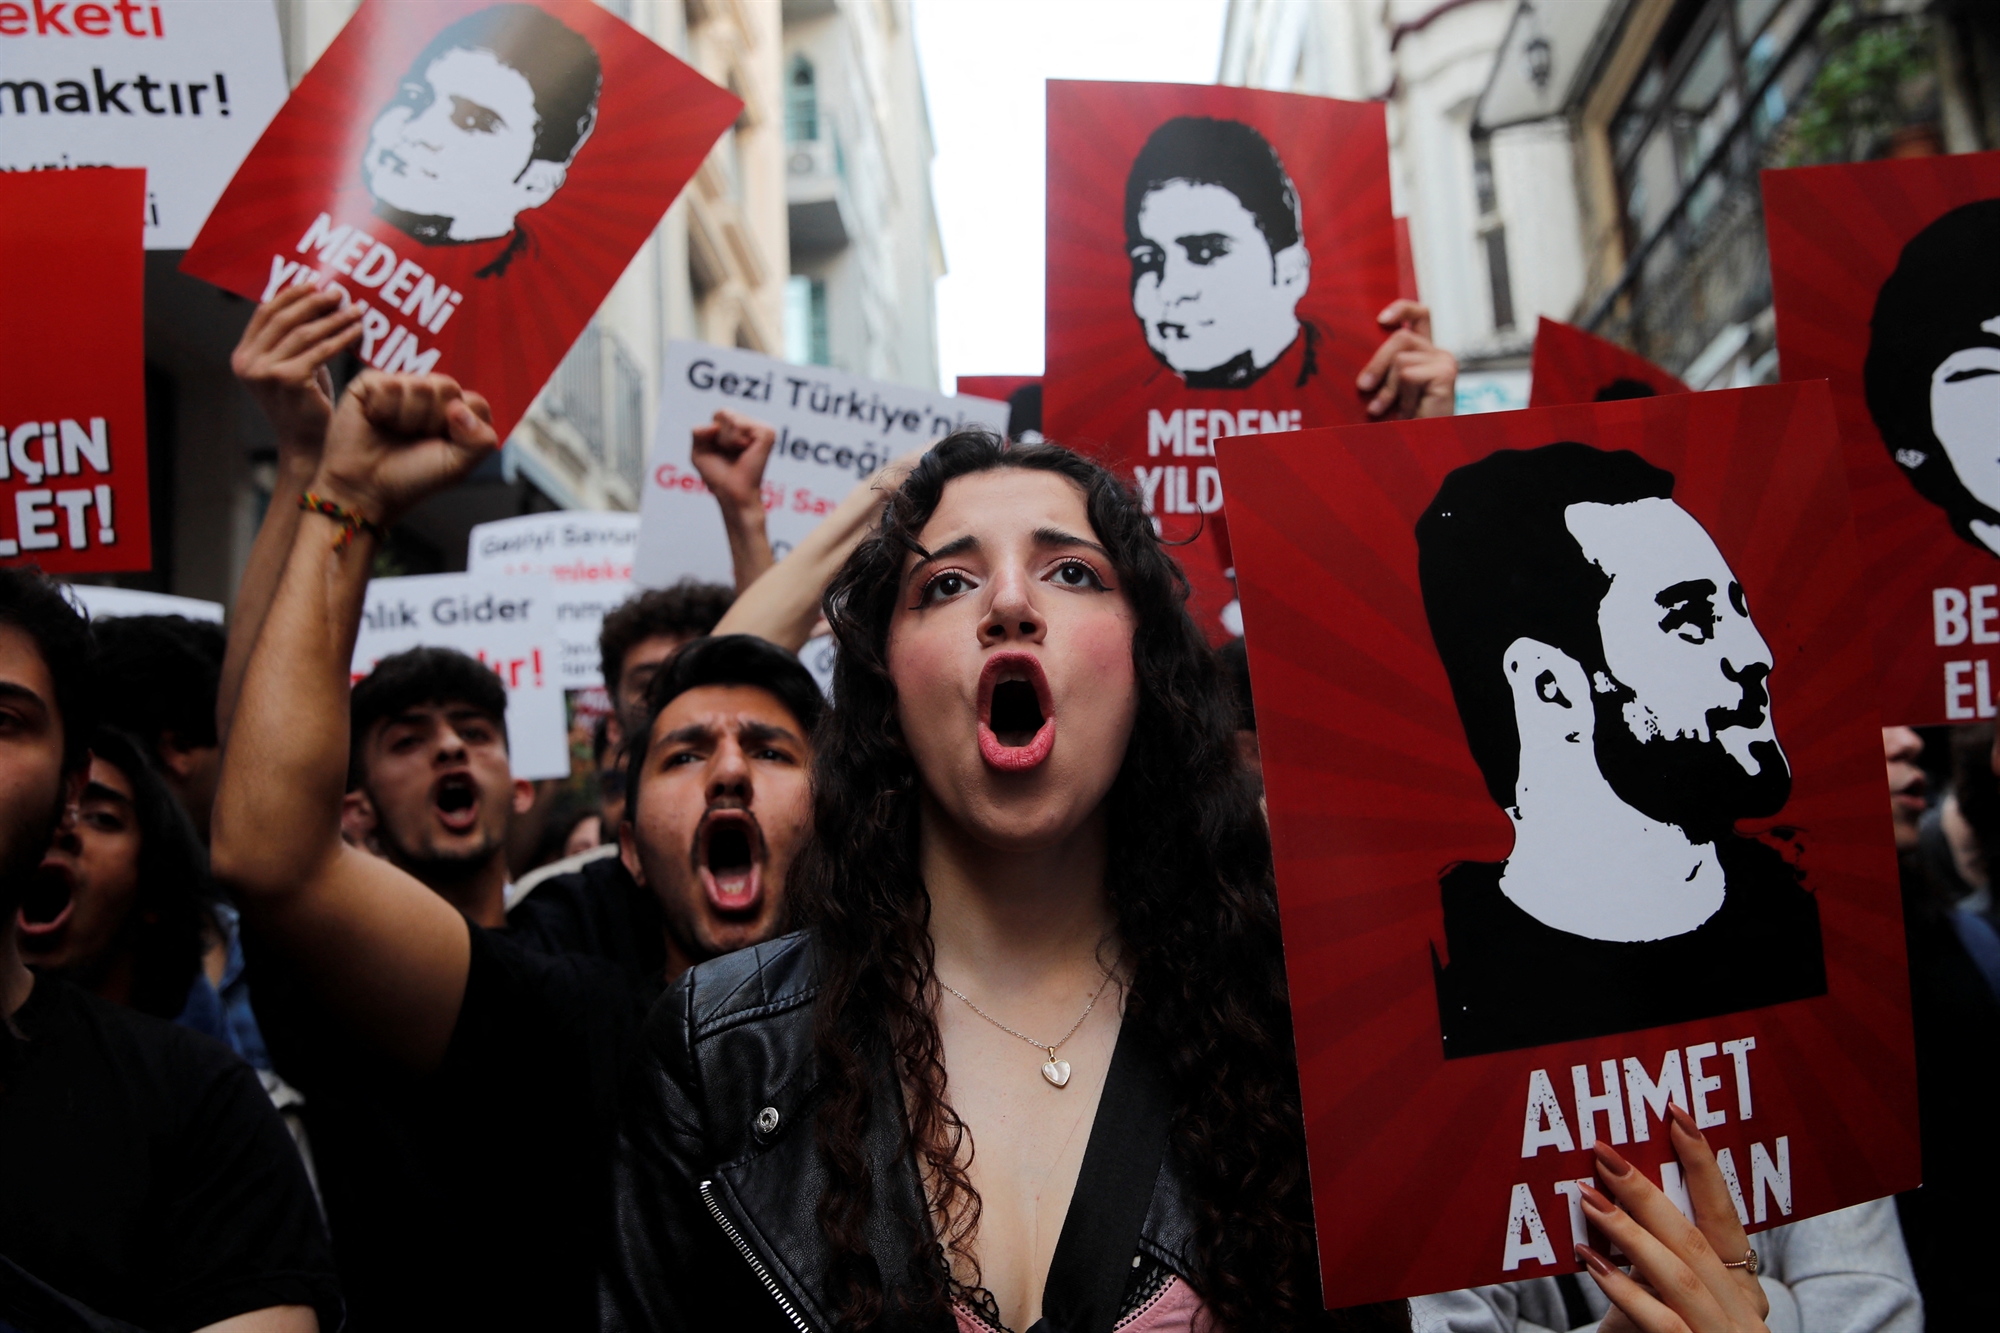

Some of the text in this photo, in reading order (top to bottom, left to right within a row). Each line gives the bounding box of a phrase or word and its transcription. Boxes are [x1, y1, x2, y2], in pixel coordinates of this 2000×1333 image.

[687, 360, 775, 402] Gezi
[432, 593, 532, 626] Gider
[1932, 584, 2000, 647] BE
[1944, 659, 1998, 720] EL
[1521, 1036, 1756, 1158] AHMET
